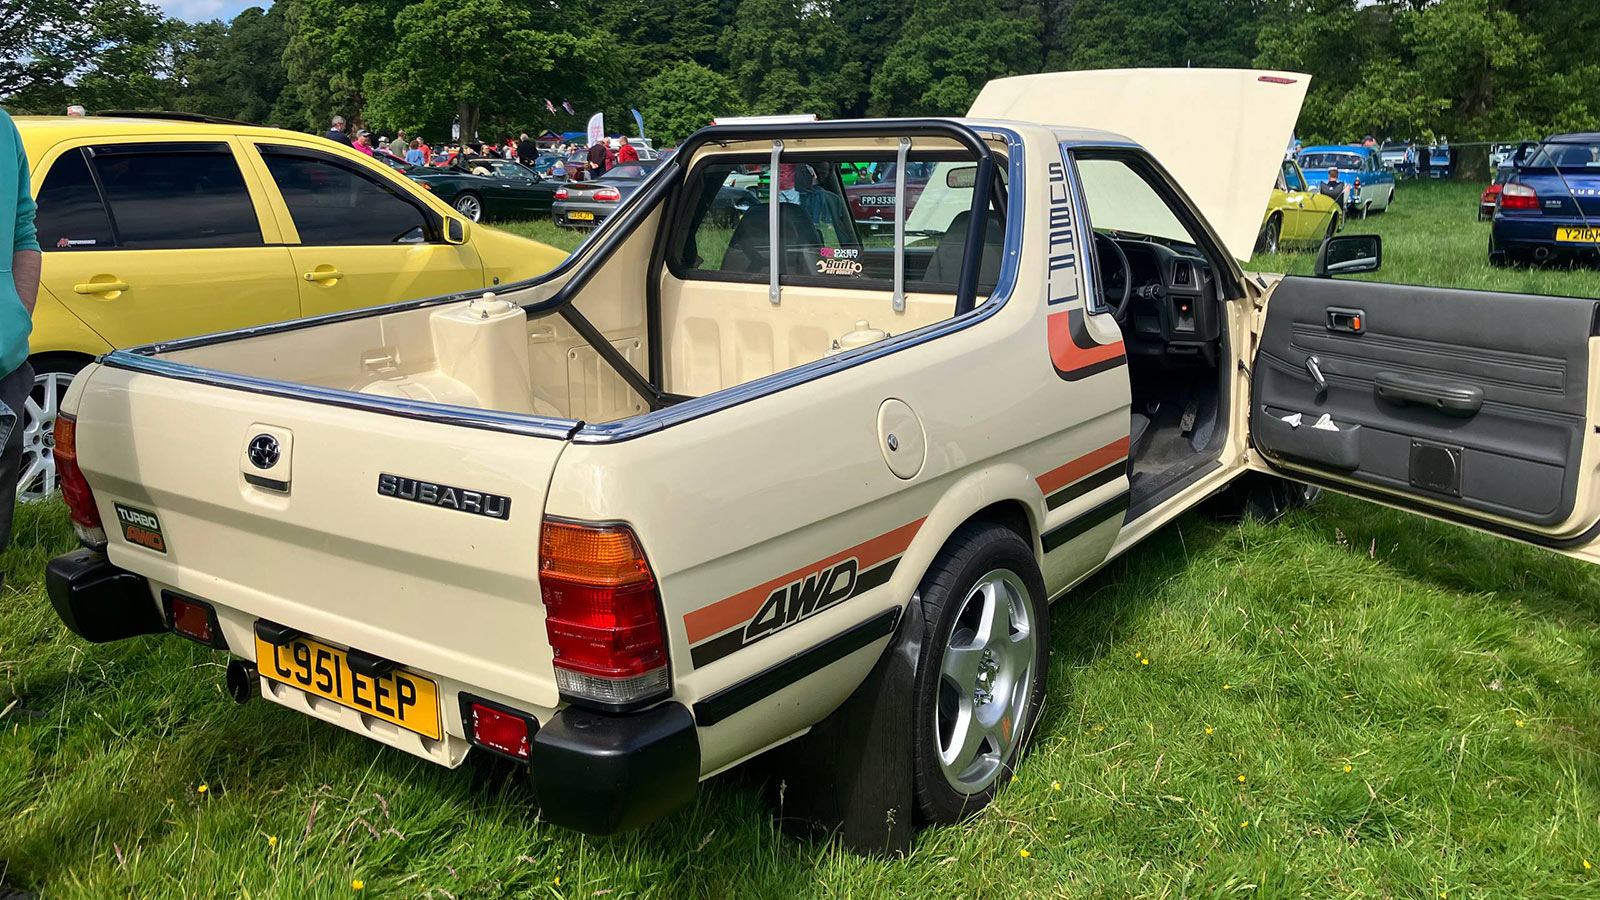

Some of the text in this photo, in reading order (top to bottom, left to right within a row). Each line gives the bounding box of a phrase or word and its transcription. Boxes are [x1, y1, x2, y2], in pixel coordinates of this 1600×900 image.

[1048, 162, 1079, 306] SUBARU
[826, 259, 856, 270] Built
[117, 507, 158, 529] TURBO
[379, 473, 505, 517] SUBARU
[743, 557, 858, 643] 4WD
[351, 668, 417, 721] EEP
